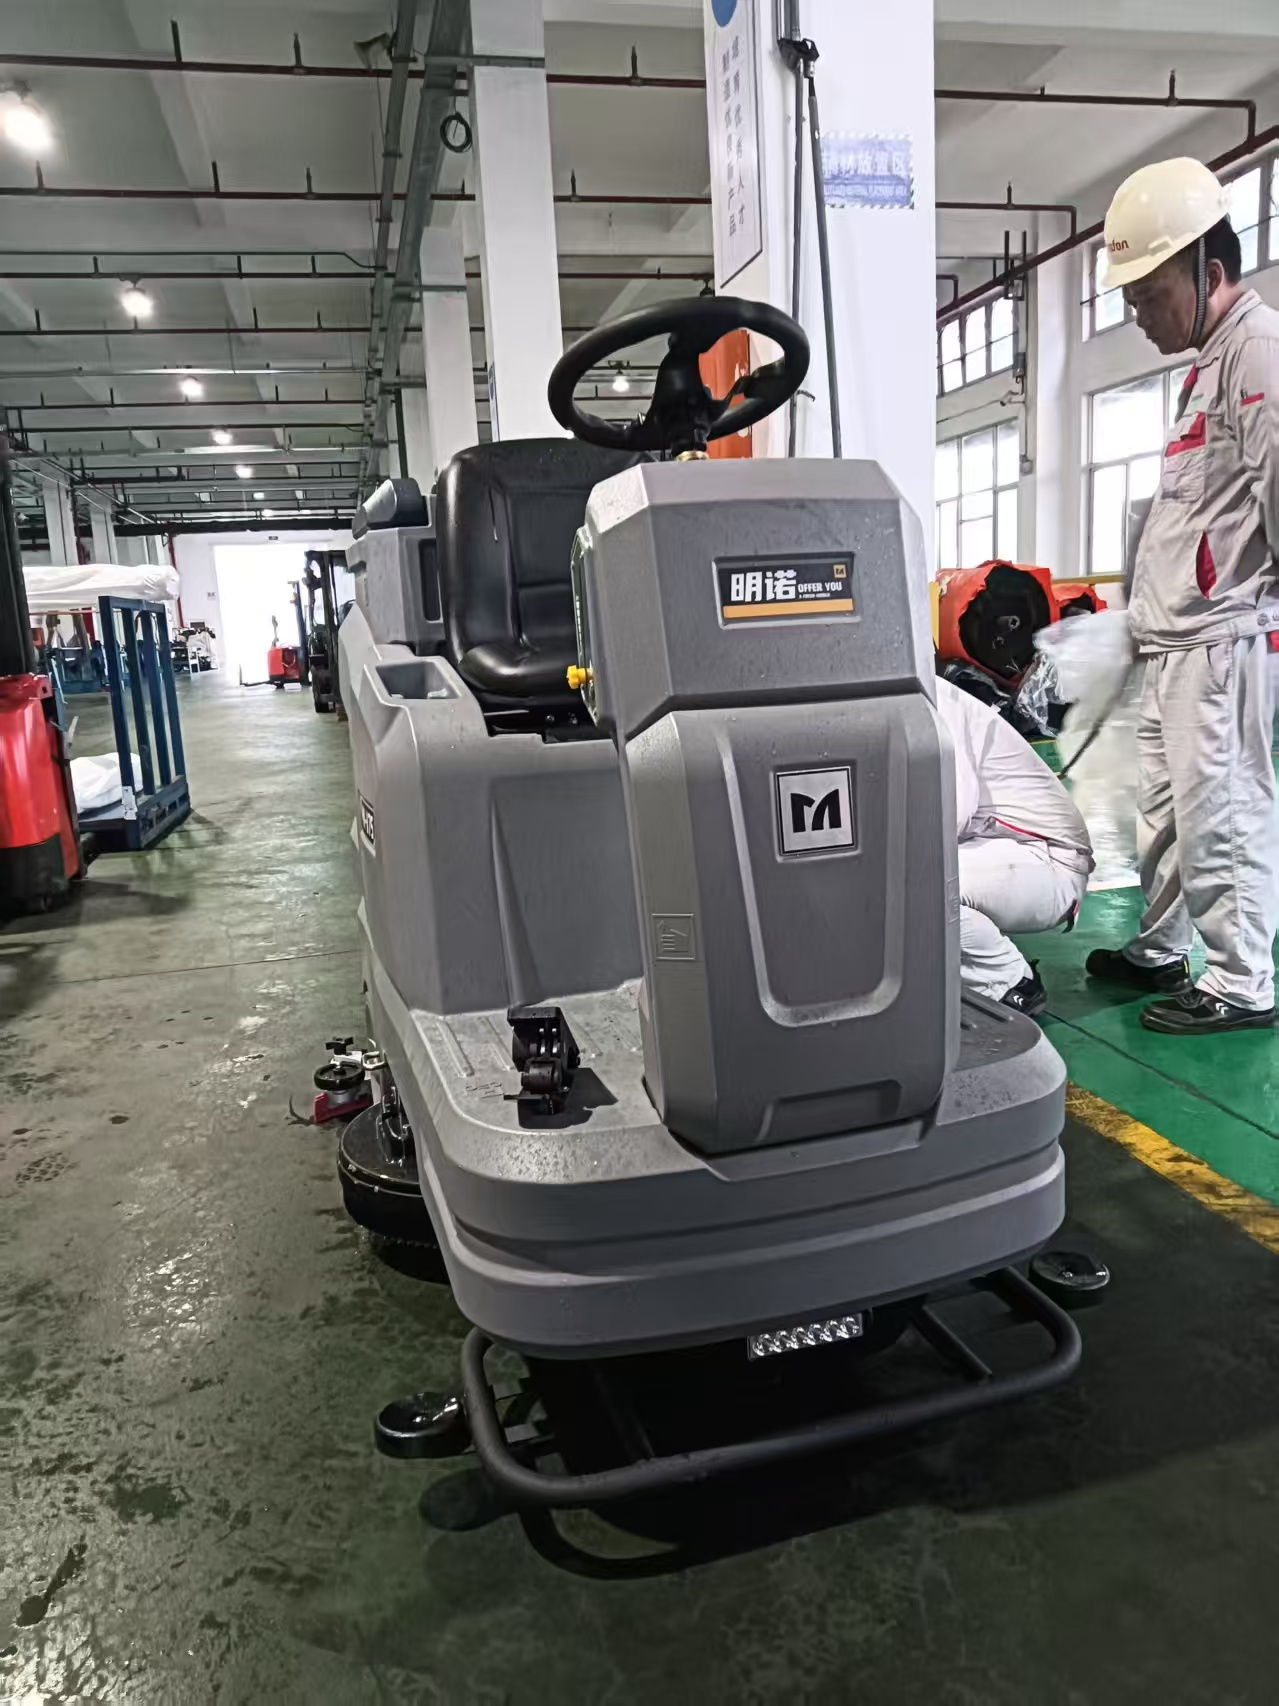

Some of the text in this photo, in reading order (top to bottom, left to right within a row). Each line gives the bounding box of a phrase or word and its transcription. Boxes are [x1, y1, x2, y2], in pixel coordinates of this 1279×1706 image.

[731, 570, 797, 602] 明诺
[798, 581, 842, 593] OFFER YOU
